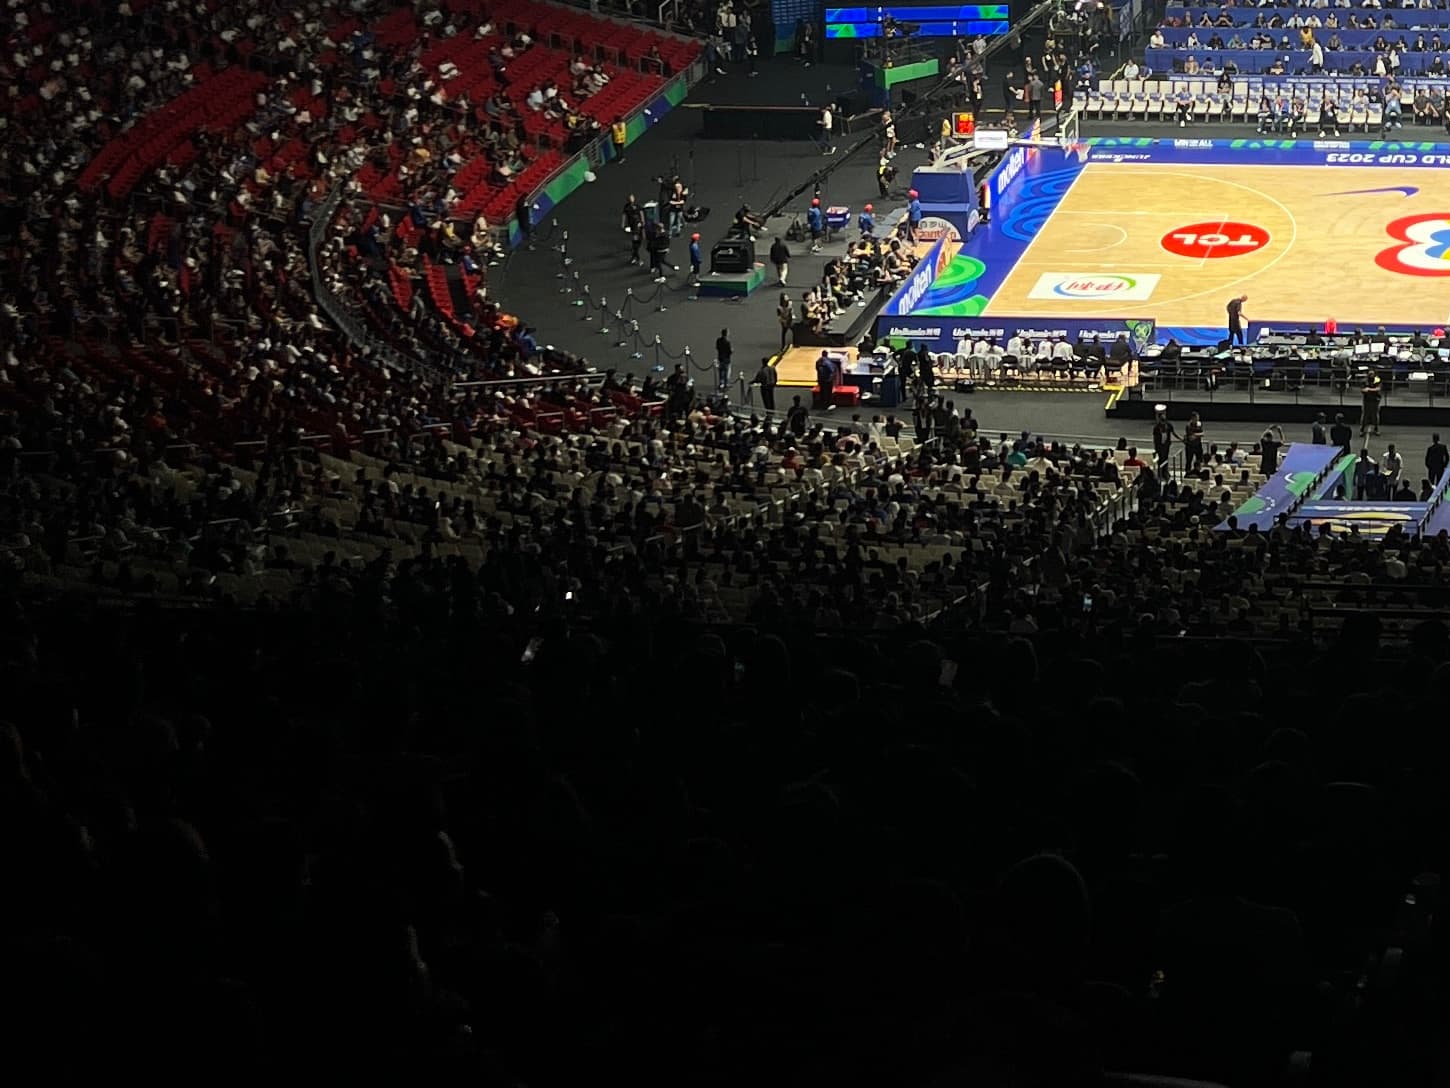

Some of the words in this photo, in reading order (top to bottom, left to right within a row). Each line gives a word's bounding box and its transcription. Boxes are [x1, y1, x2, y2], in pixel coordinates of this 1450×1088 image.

[1326, 153, 1375, 163] 2023
[1379, 154, 1418, 164] CUP
[998, 147, 1024, 194] molten
[1173, 233, 1259, 247] TCL
[899, 264, 932, 316] molten
